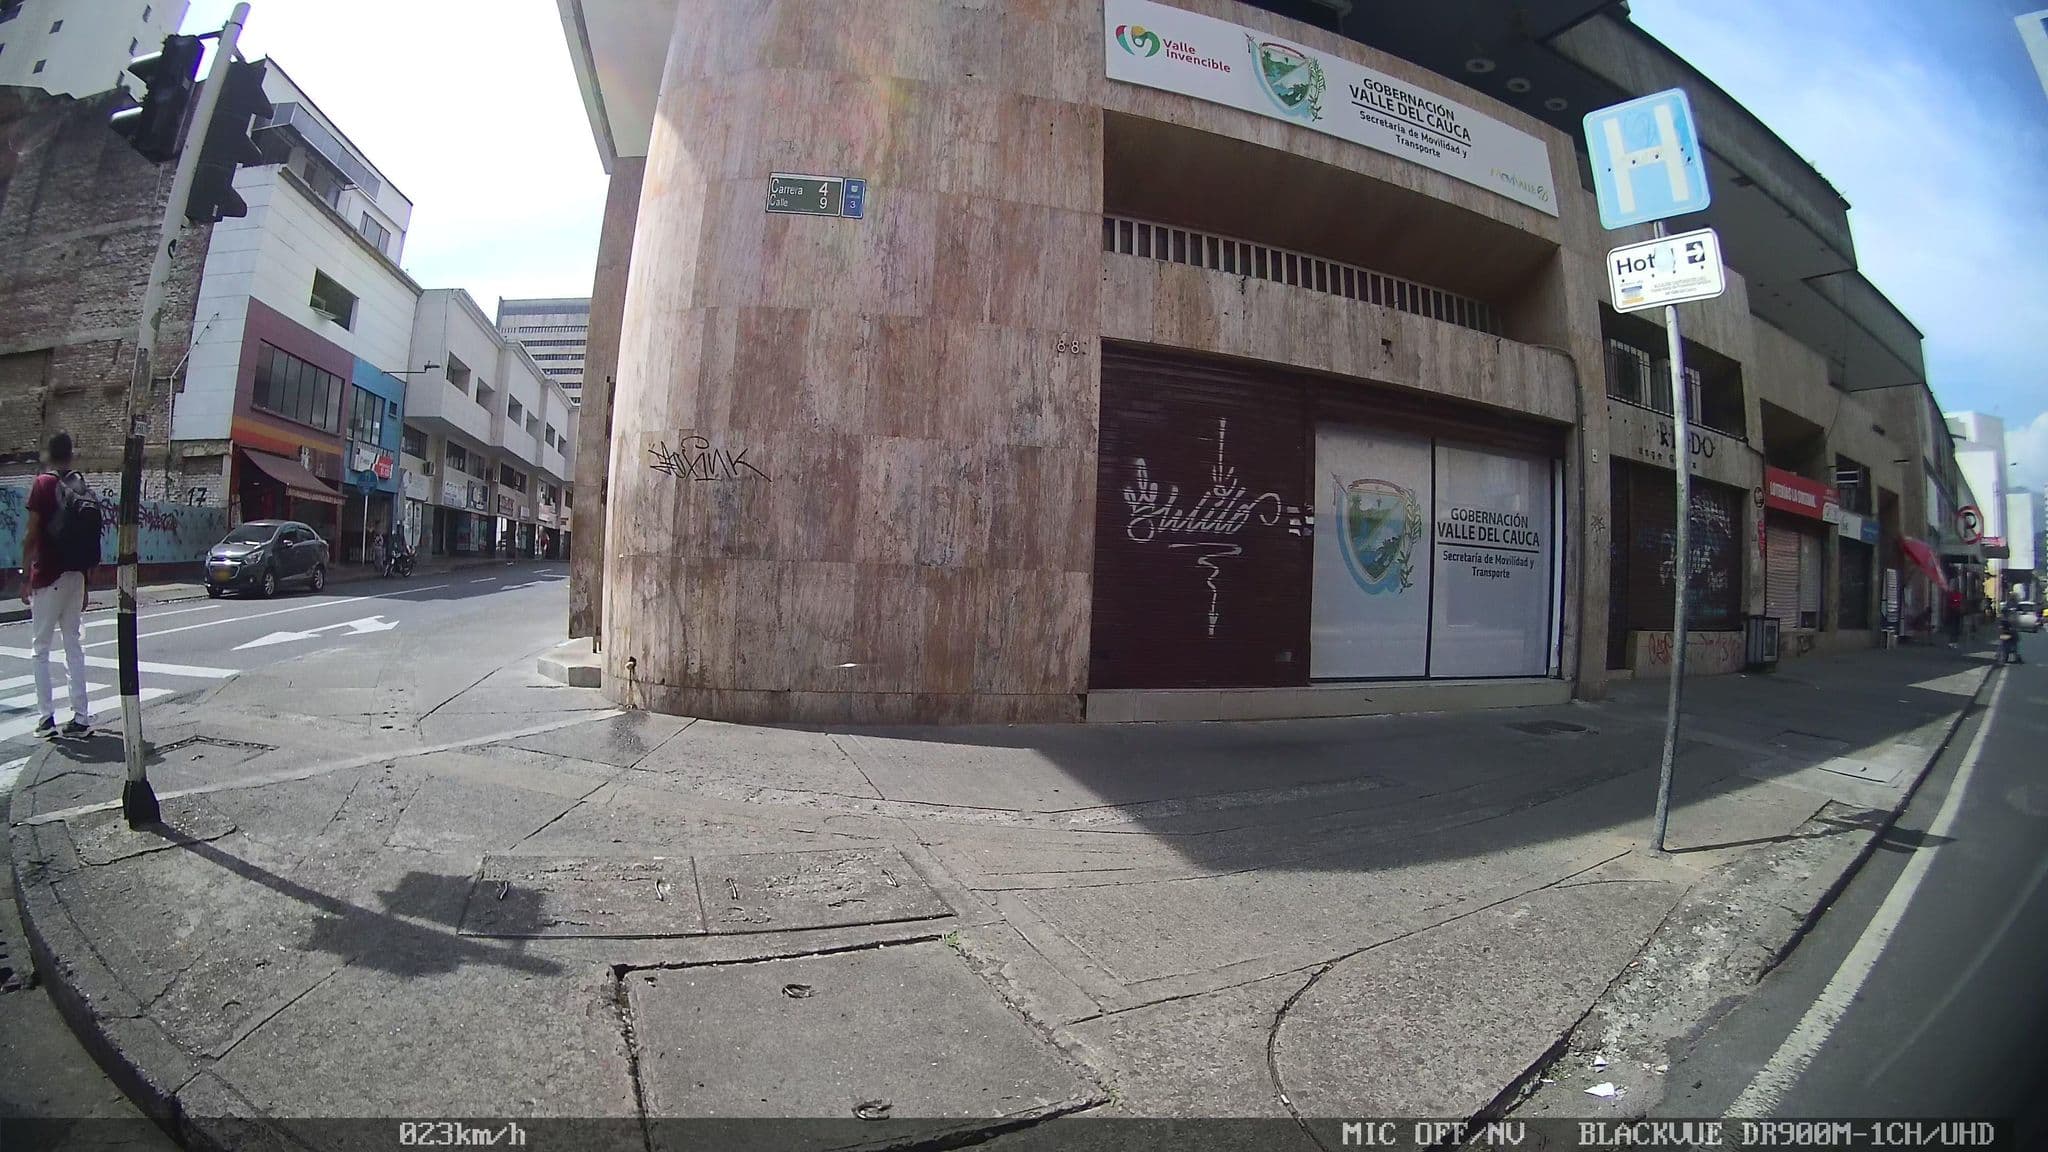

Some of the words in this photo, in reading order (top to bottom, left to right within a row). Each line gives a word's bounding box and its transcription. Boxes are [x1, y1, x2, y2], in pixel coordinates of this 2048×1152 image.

[1163, 38, 1196, 54] Valle
[1166, 49, 1231, 73] Invencible
[1363, 78, 1454, 121] GOBERNACIÓN
[1349, 84, 1394, 112] VALLE
[1397, 103, 1424, 123] DEL
[1427, 114, 1471, 142] CAUCA
[1360, 111, 1406, 134] Secretaría
[1408, 128, 1419, 139] de
[1421, 132, 1460, 155] Movilidad
[1461, 149, 1467, 159] y
[1395, 134, 1441, 158] Transporte
[1603, 104, 1690, 214] H
[771, 178, 803, 195] Carrera
[819, 182, 828, 196] 4
[769, 193, 788, 207] Calle
[819, 197, 828, 209] 9
[1451, 508, 1528, 528] GOBERNACIÓN
[1437, 521, 1475, 540] VALLE
[1478, 525, 1500, 543] DEL
[1503, 529, 1540, 547] CAUCA
[1443, 550, 1482, 564] Secretaría
[1484, 553, 1493, 564] de
[1495, 554, 1529, 568] Movilidad
[1529, 559, 1534, 569] y
[1472, 566, 1510, 580] Transporte
